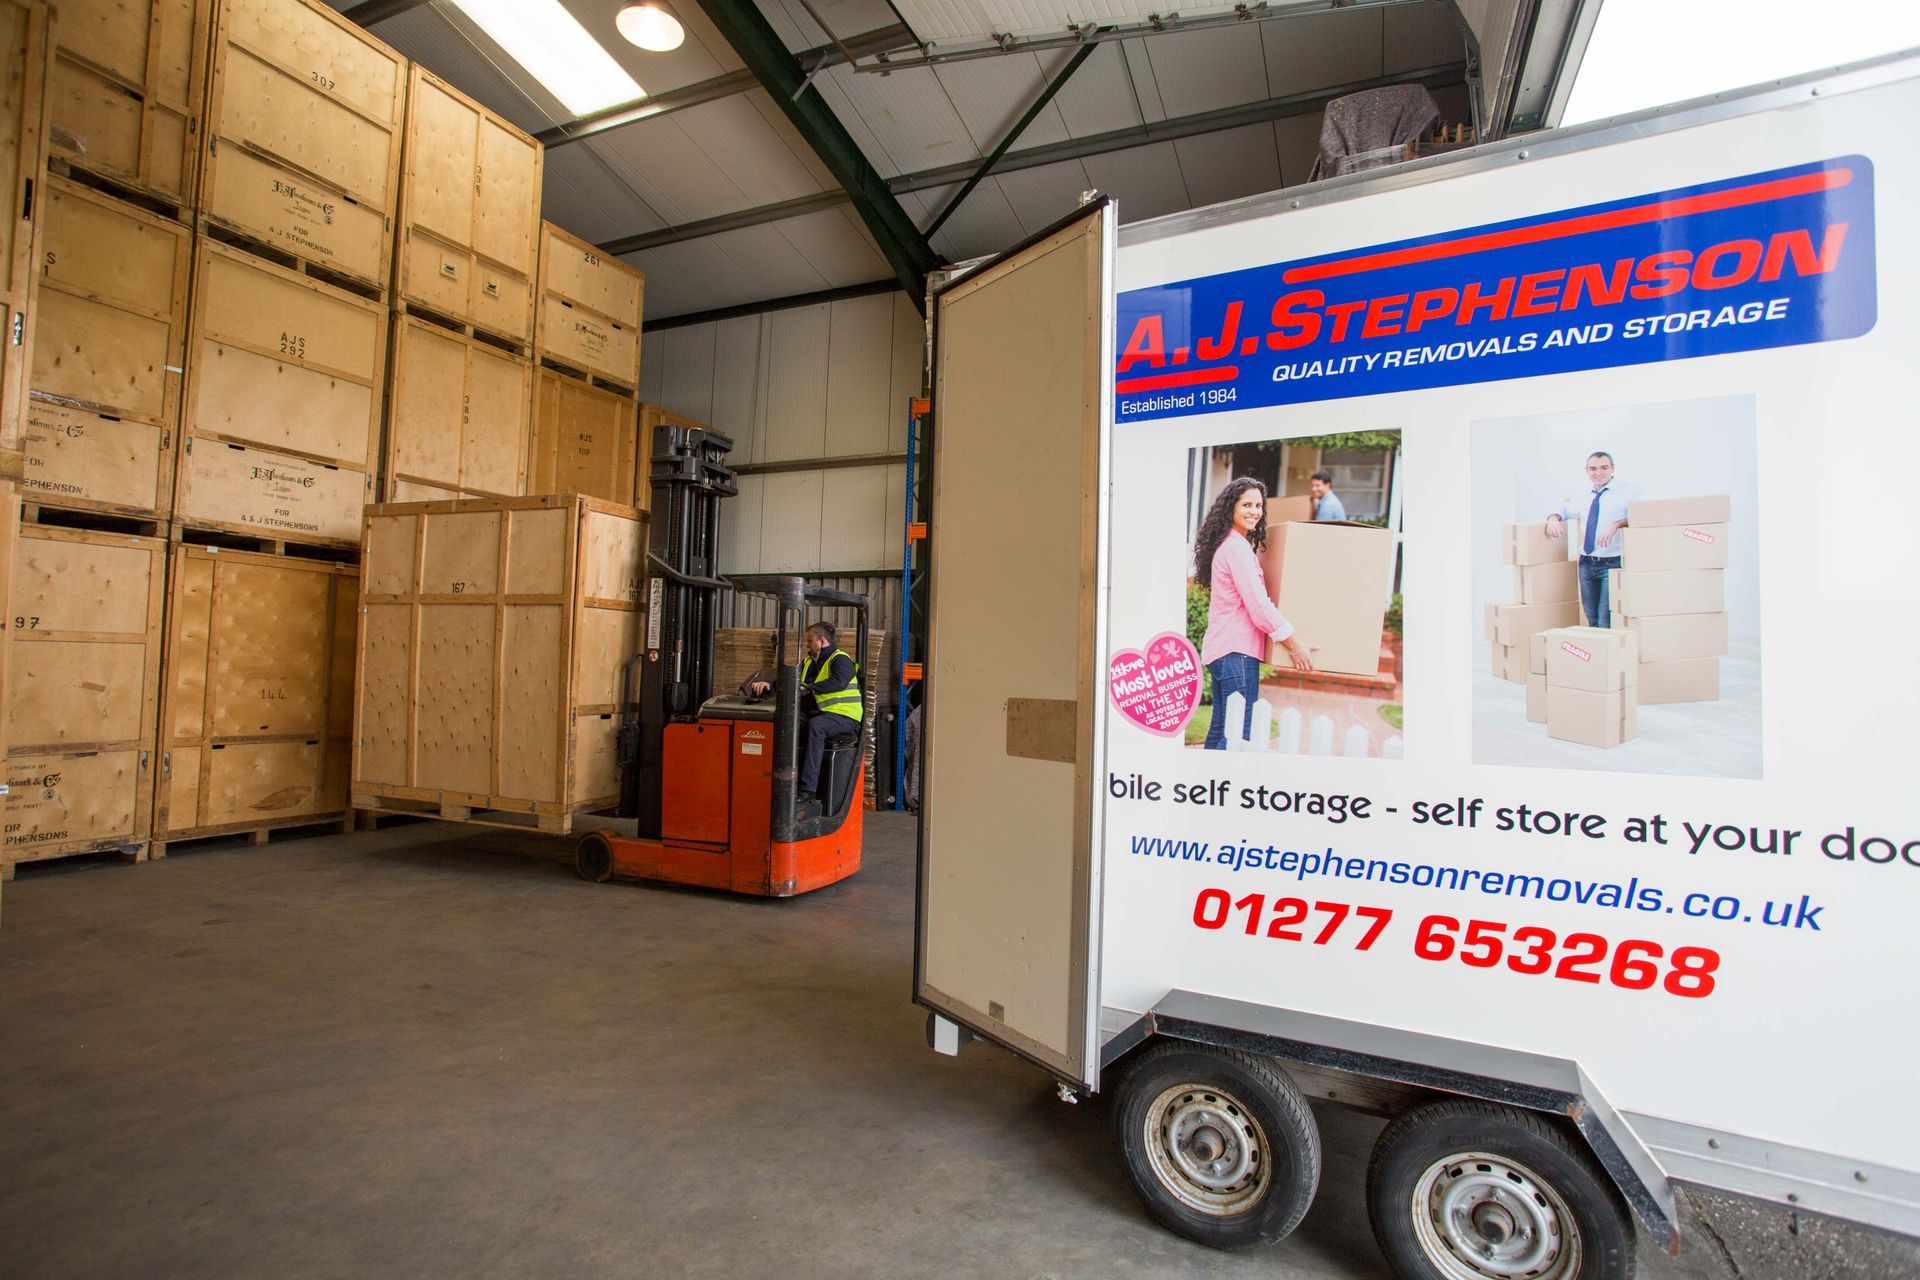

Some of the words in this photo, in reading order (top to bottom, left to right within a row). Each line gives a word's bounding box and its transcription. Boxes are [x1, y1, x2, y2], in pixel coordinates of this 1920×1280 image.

[311, 71, 335, 90] 307
[293, 225, 309, 237] FOR
[286, 232, 333, 256] STEPHENSON
[584, 252, 600, 268] 261
[1272, 353, 1382, 382] QUALITY
[1383, 333, 1537, 369] REMOVALS
[1543, 323, 1613, 349] AND
[1623, 298, 1790, 338] STORAGE
[280, 343, 305, 359] 292
[1121, 393, 1194, 415] Established
[1199, 387, 1237, 405] 1984
[274, 508, 290, 517] FOR
[264, 518, 319, 532] STEPHENSONS
[451, 582, 466, 593] 167
[1113, 670, 1153, 699] Most
[1150, 650, 1194, 684] loved
[1120, 690, 1157, 709] REMOVAL
[1158, 672, 1198, 694] BUSINESS
[1134, 704, 1148, 715] IN
[1149, 694, 1172, 709] THE
[1174, 686, 1192, 700] UK
[1156, 704, 1175, 715] VOTED
[1166, 704, 1190, 718] PEOPLE
[1160, 716, 1180, 729] 2012
[1109, 773, 1162, 801] bile
[1173, 780, 1230, 806] self
[1240, 785, 1372, 823] storage
[1412, 797, 1484, 828] self
[1495, 804, 1607, 839] store
[1623, 814, 1668, 845] at
[1682, 822, 1802, 855] your
[6, 832, 68, 845] PHENSONS
[1131, 835, 1825, 931] www.ajstephensonremovals.co.uk
[1193, 887, 1393, 951] 01277
[1414, 914, 1720, 998] 653268
